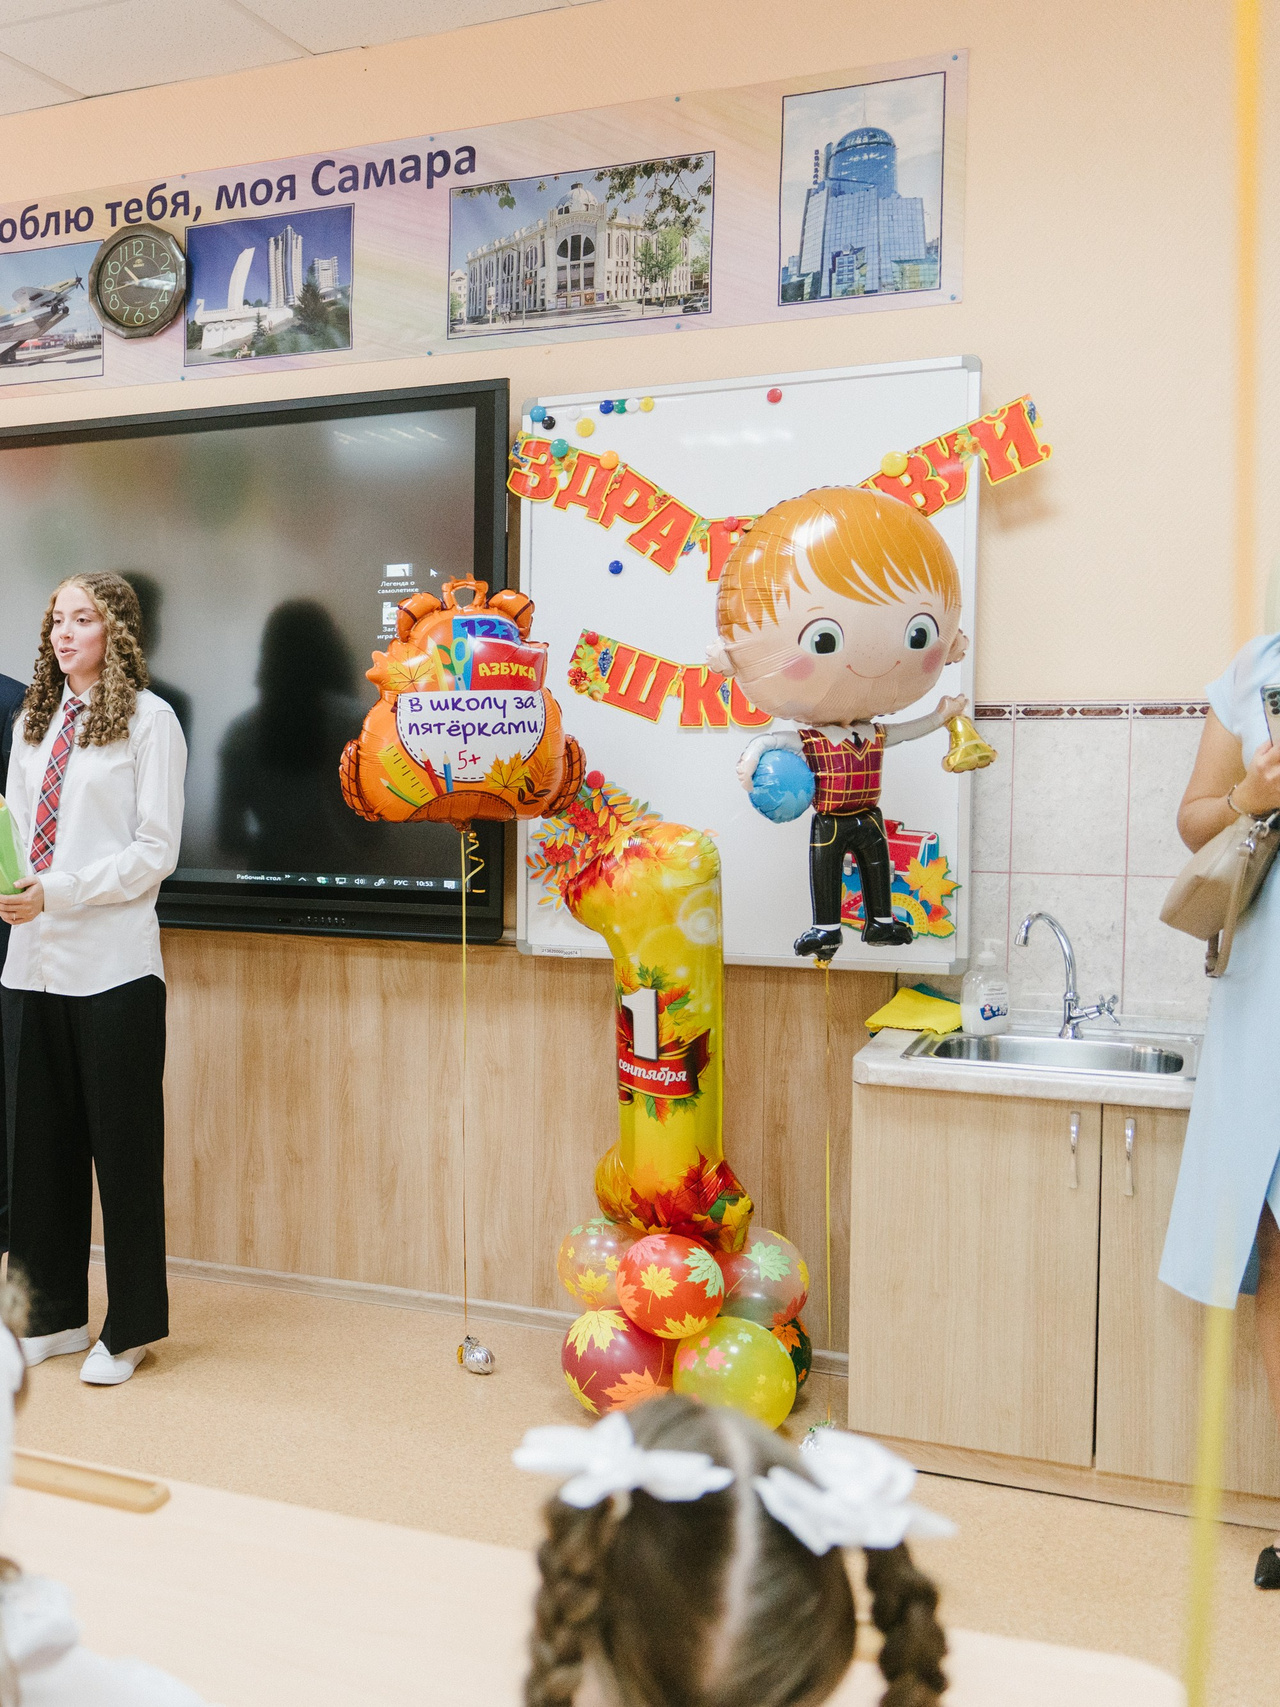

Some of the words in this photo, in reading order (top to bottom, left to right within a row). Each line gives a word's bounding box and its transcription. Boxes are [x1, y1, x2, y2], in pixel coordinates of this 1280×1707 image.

[105, 183, 202, 228] тебя,
[215, 174, 297, 212] моя
[311, 144, 477, 194] Самара
[119, 246, 128, 262] 11
[132, 240, 144, 257] 12
[151, 243, 156, 259] 1
[107, 260, 121, 276] 10
[160, 252, 170, 271] 2
[104, 277, 115, 294] 9
[109, 294, 120, 310] 8
[158, 288, 169, 305] 4
[122, 306, 130, 321] 7
[133, 308, 145, 325] 6
[147, 302, 160, 320] 5
[460, 619, 515, 641] 123
[478, 662, 538, 682] АЗБУКА
[408, 697, 423, 713] В
[429, 696, 508, 719] школу
[515, 695, 537, 710] за
[408, 720, 539, 745] пятёрками
[457, 750, 481, 770] 5+
[236, 873, 266, 881] Рабочий
[621, 987, 659, 1061] 1
[618, 1058, 687, 1086] сентября
